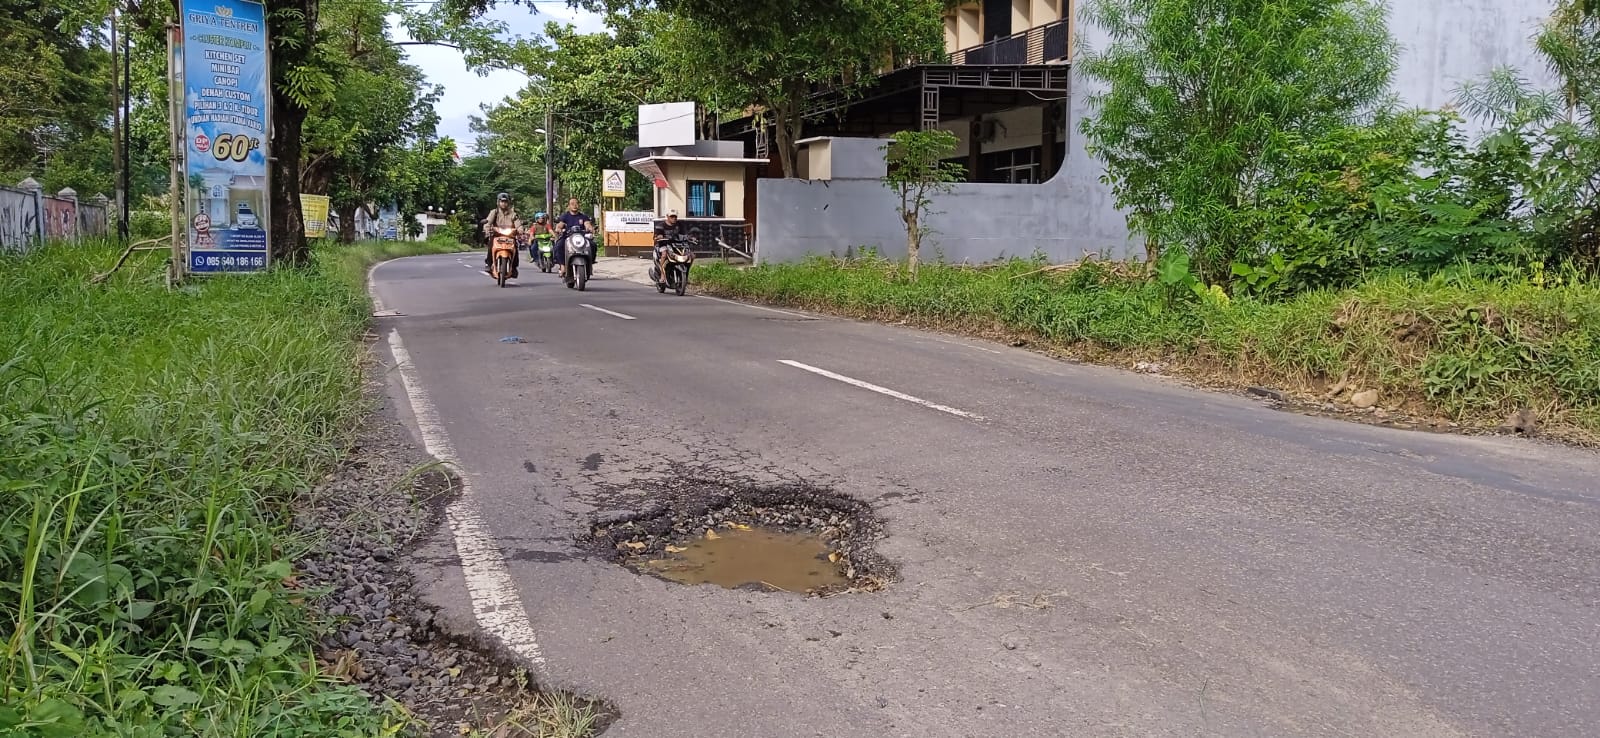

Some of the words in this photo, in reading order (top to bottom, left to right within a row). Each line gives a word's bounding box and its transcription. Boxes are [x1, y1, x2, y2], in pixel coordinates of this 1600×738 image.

[189, 13, 217, 27] GRIYA
[220, 18, 258, 33] TENTREM
[205, 50, 233, 62] KITCHEN
[234, 54, 246, 64] SET
[211, 63, 240, 76] MINIBAR
[214, 76, 238, 88] CANOPI
[201, 88, 223, 98] DENAH
[225, 89, 251, 102] CUSTOM
[241, 105, 259, 118] TIDUR
[213, 133, 249, 162] 60
[207, 256, 220, 266] 085
[236, 256, 249, 266] 186
[250, 257, 263, 266] 166
